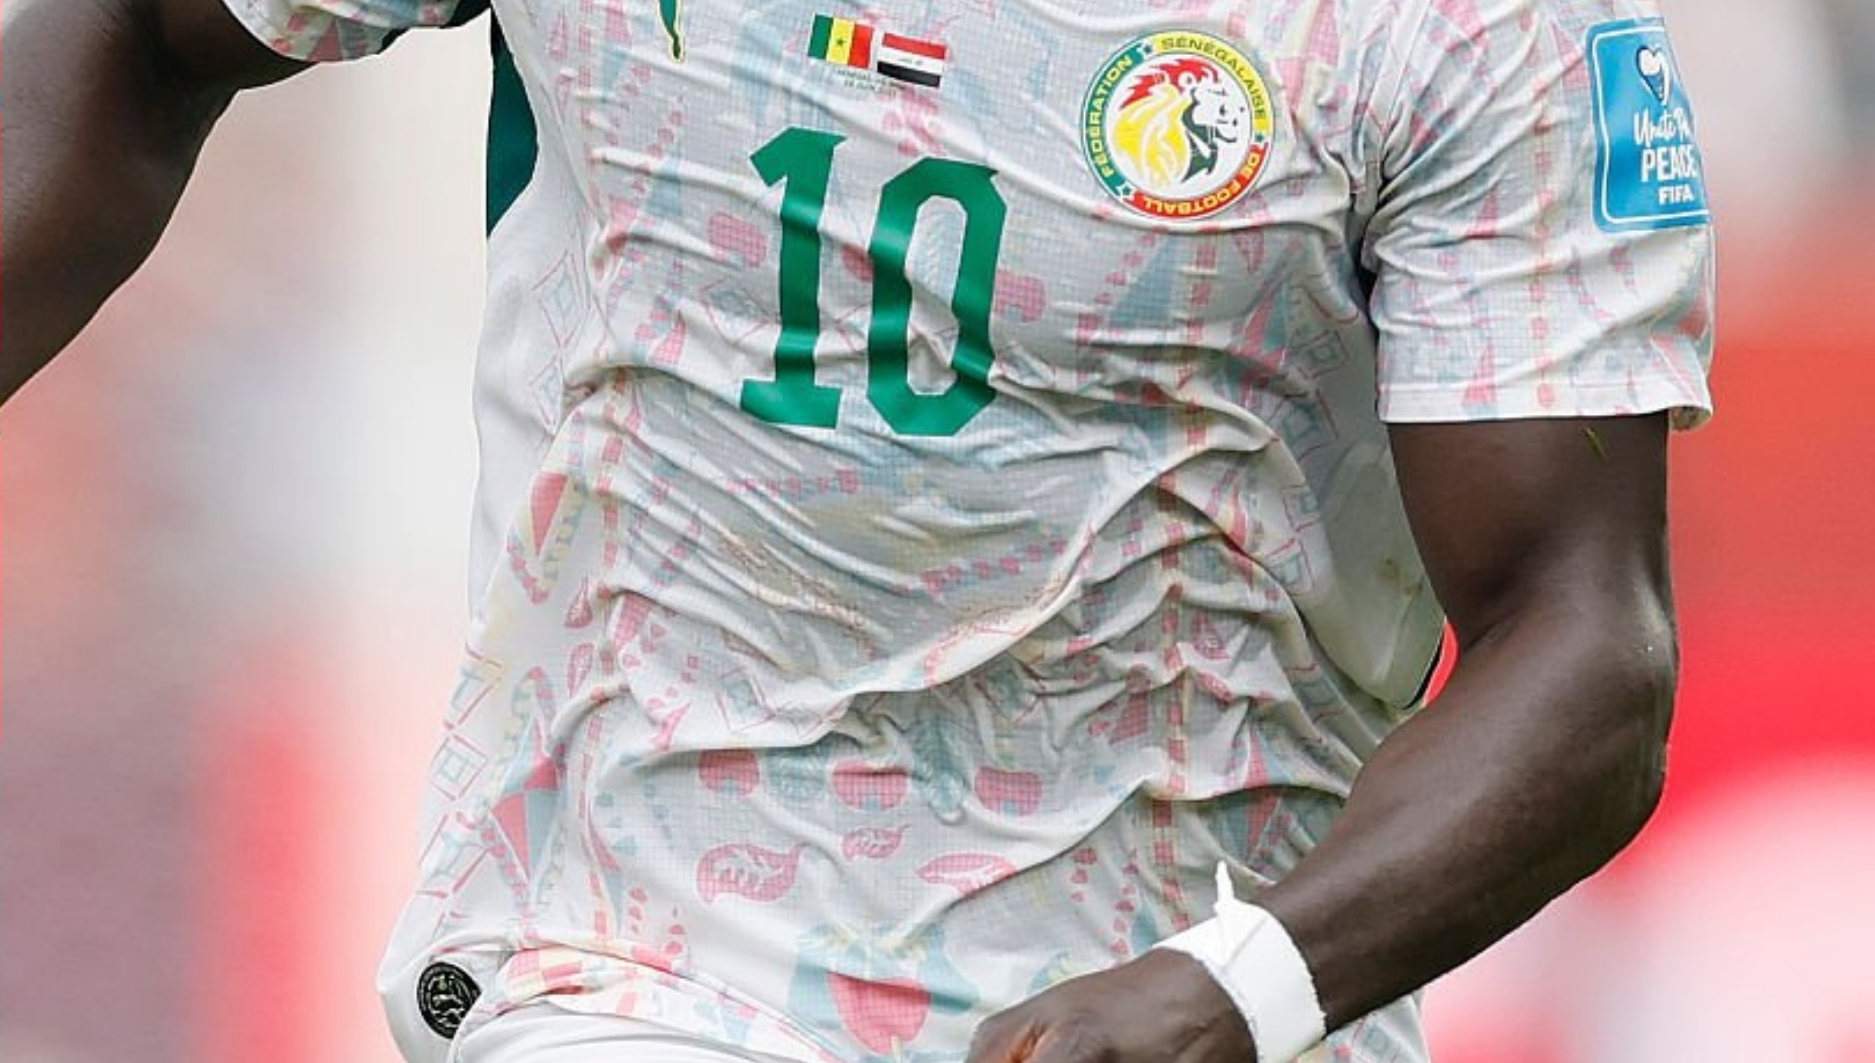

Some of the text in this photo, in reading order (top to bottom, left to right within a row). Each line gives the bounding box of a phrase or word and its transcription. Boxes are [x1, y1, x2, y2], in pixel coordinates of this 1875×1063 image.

[1242, 151, 1262, 181] DE
[1640, 143, 1698, 183] PEACE
[1142, 179, 1243, 217] FOOTBALL
[1658, 184, 1695, 205] FIFA
[739, 125, 1009, 436] 10
